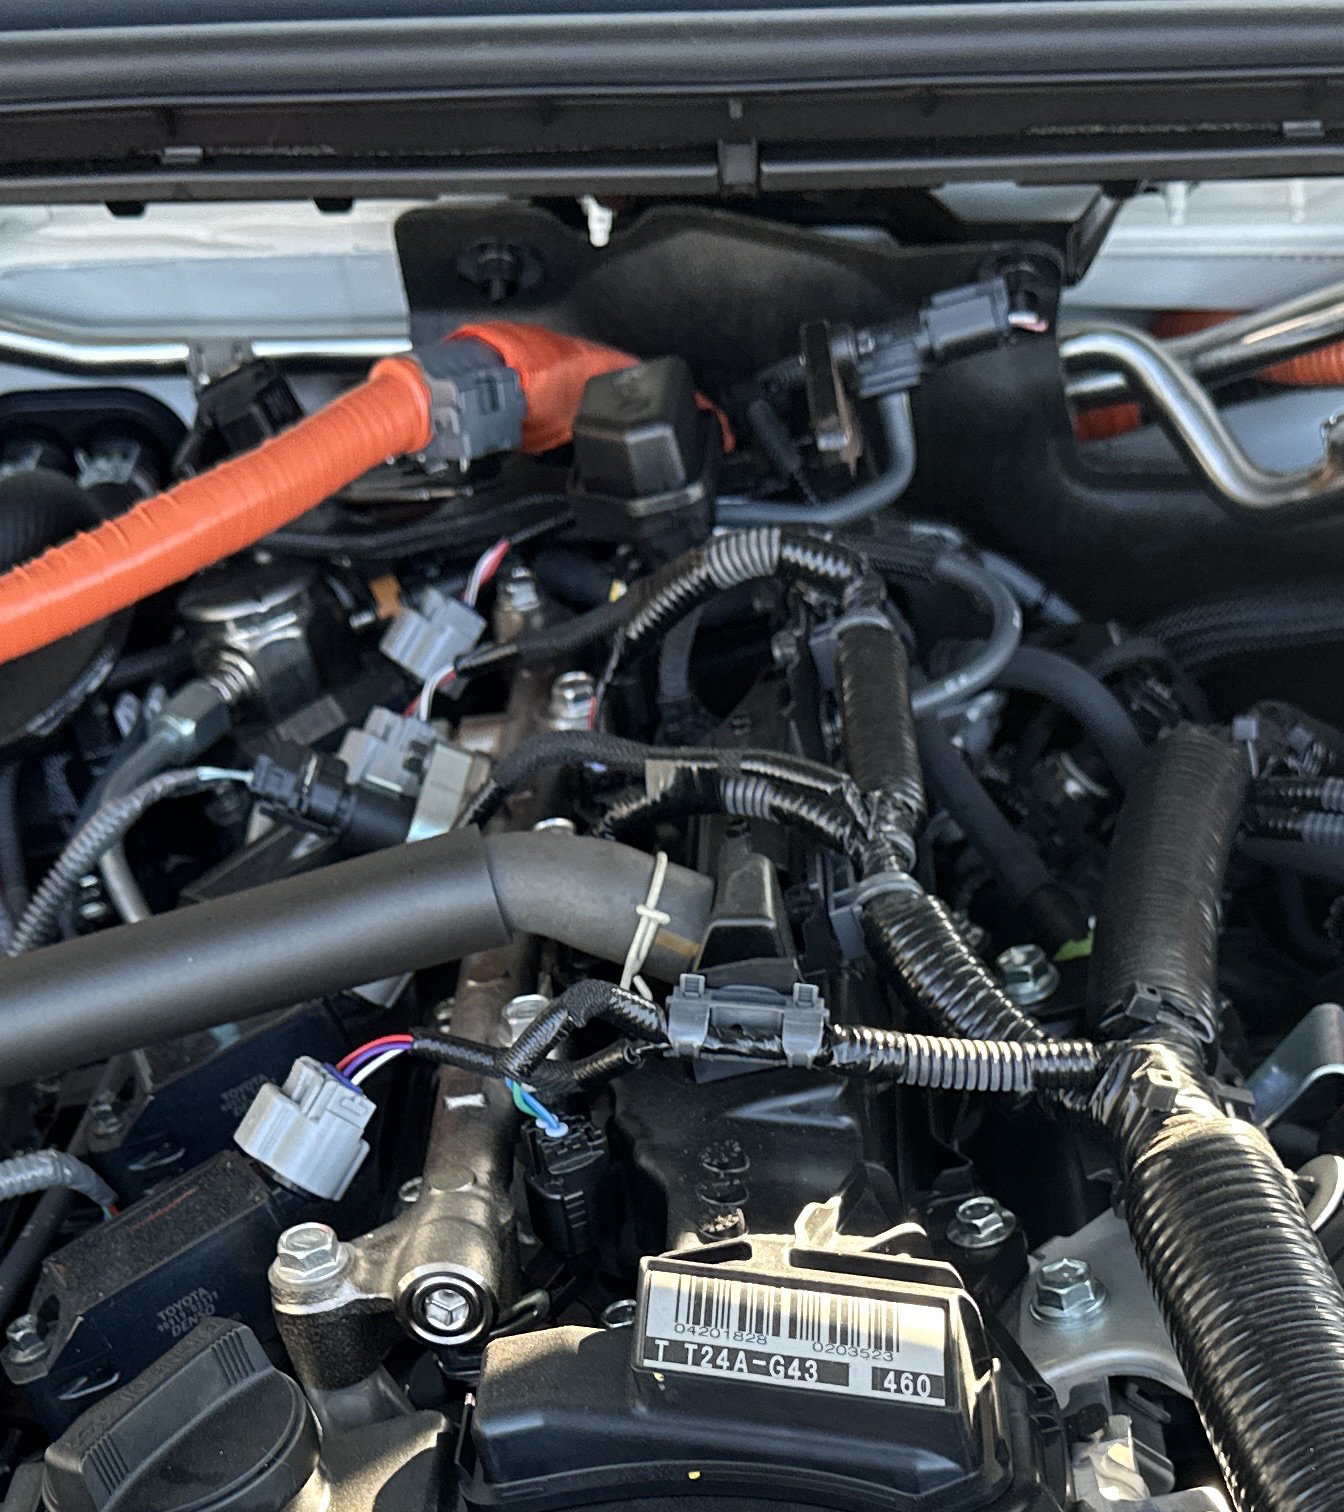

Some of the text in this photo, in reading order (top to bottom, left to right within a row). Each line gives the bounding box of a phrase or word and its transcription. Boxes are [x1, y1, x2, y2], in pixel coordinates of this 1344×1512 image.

[158, 1287, 211, 1320] TOYOTA
[170, 1302, 216, 1338] DENSO
[673, 1321, 895, 1363] 04201828 0203523
[654, 1340, 932, 1398] T T24A-G43 460
